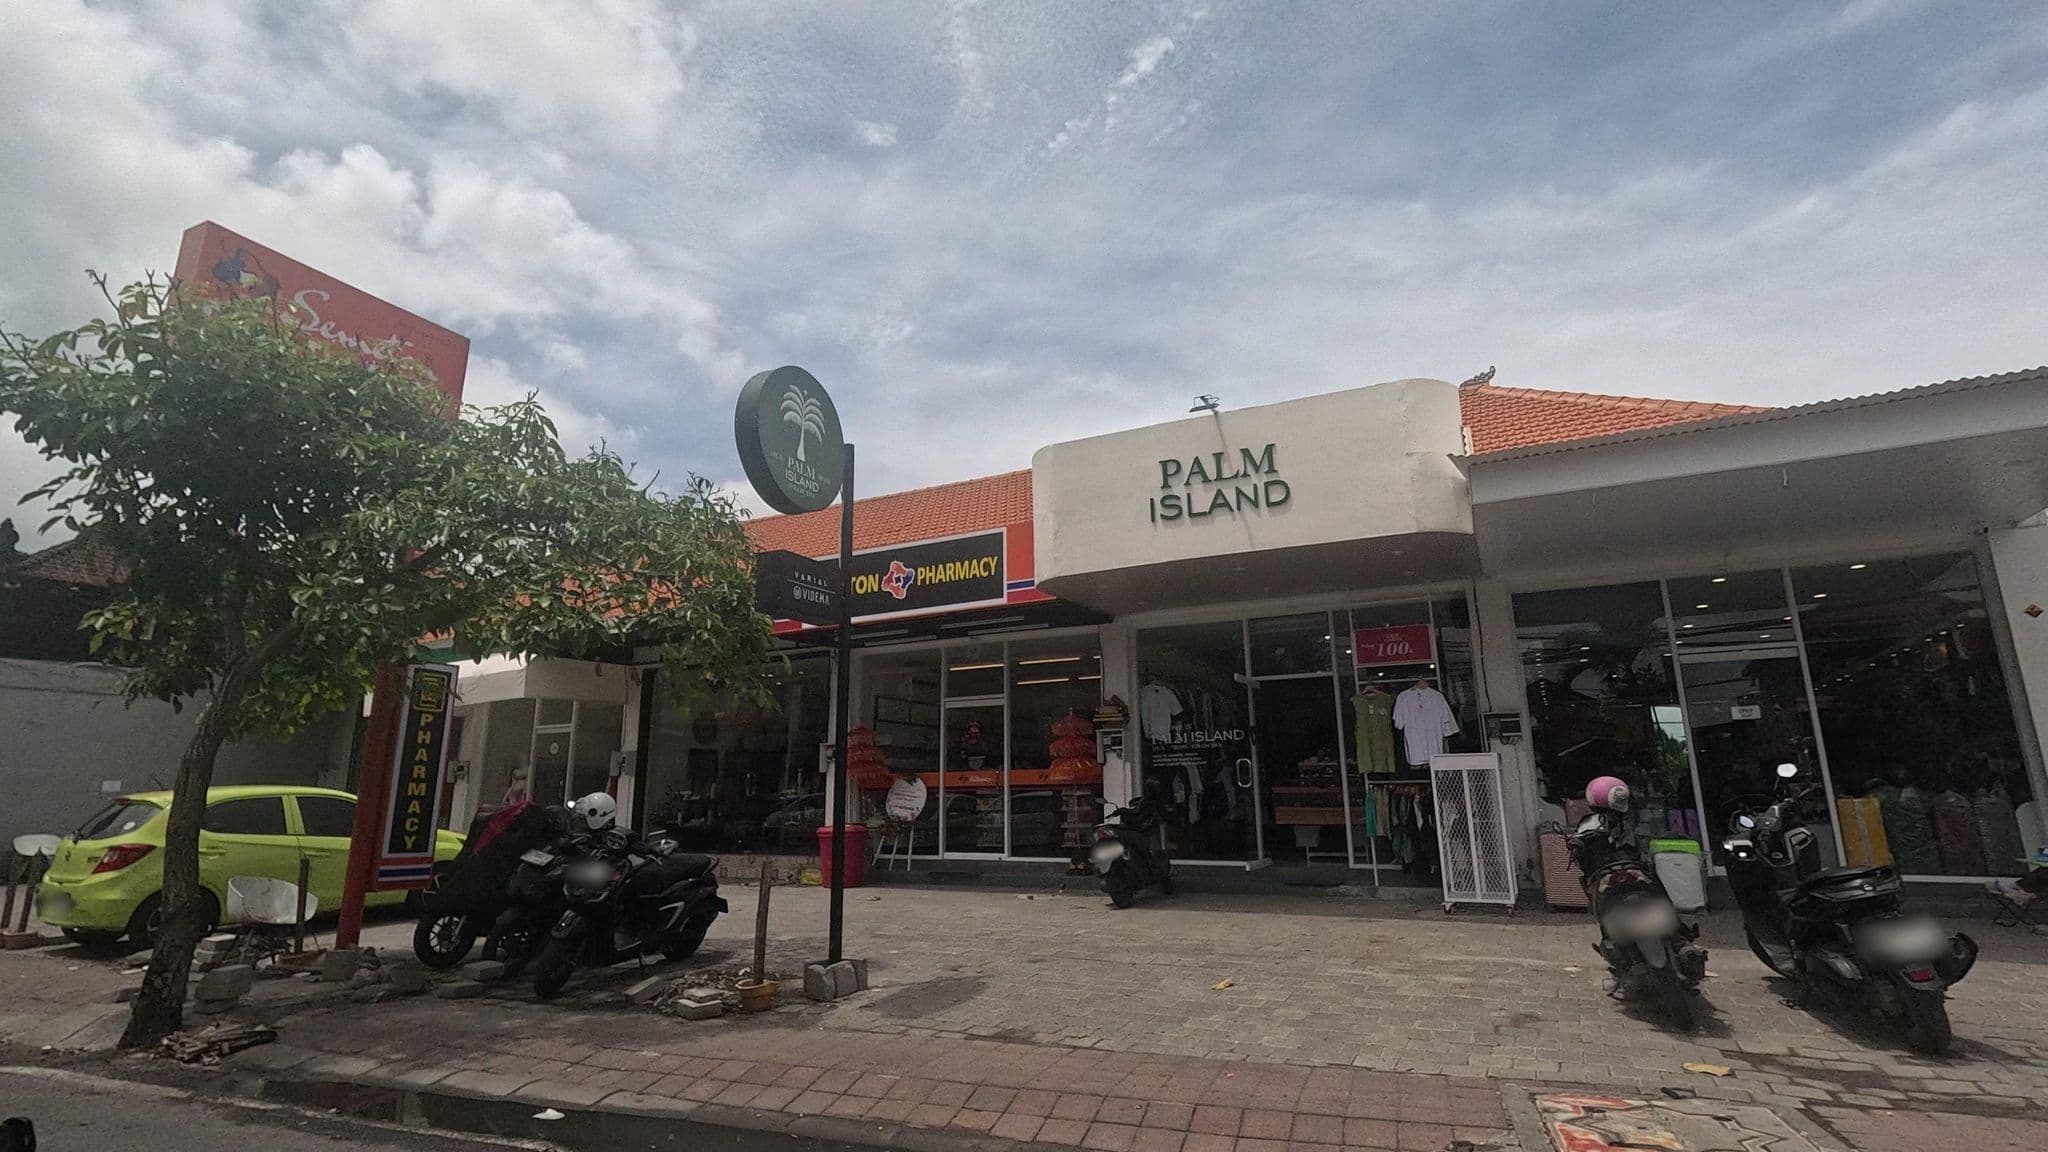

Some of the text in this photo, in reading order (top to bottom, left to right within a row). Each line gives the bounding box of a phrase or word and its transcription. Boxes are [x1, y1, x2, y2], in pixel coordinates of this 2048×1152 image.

[785, 468, 820, 493] ISLAND
[1158, 443, 1278, 489] PALM
[1150, 479, 1291, 523] ISLAND
[916, 556, 998, 586] PHARMACY
[1191, 729, 1245, 742] ISLAND
[404, 713, 434, 849] PHARMACY
